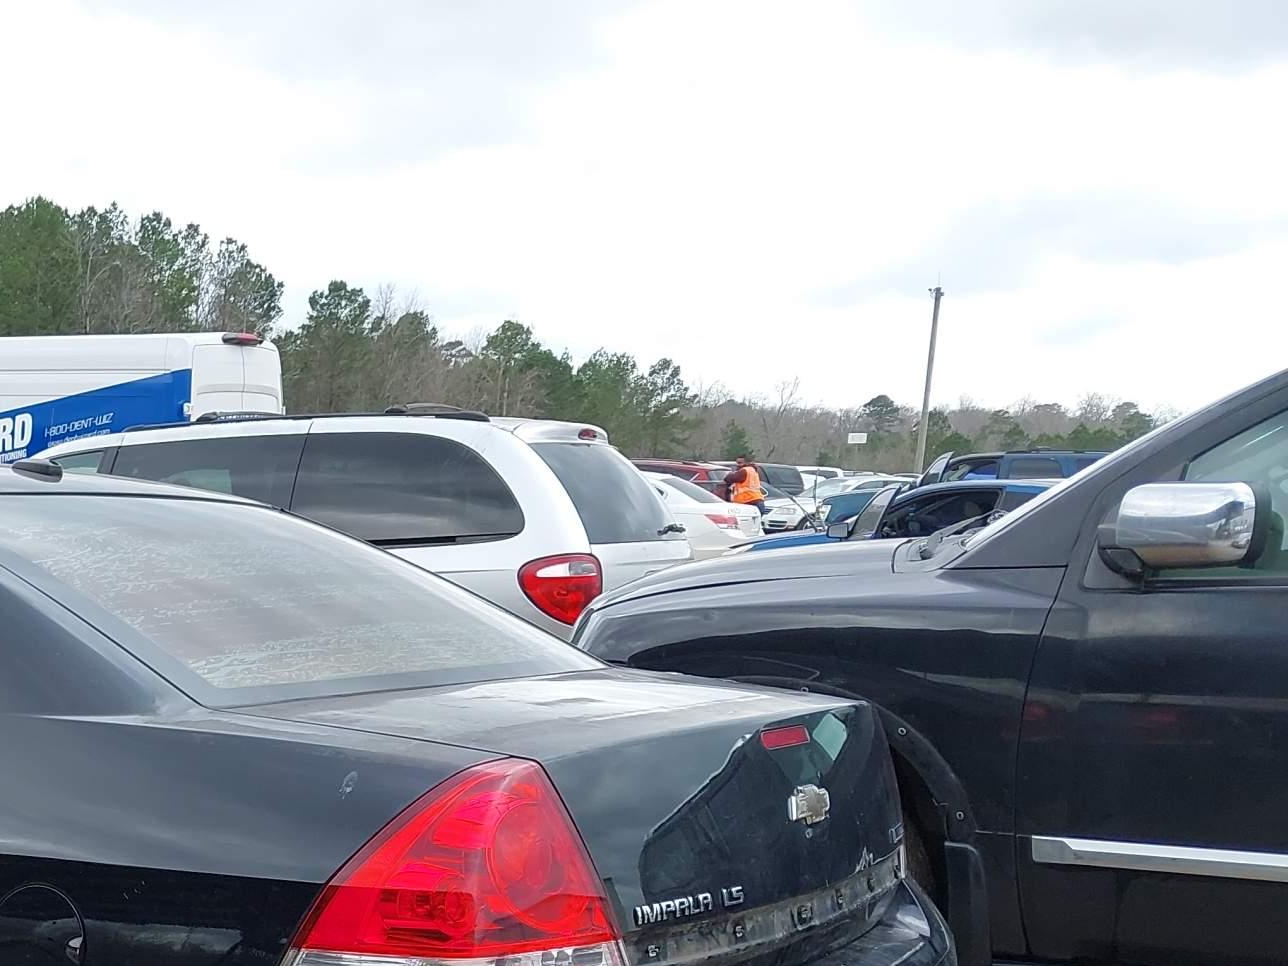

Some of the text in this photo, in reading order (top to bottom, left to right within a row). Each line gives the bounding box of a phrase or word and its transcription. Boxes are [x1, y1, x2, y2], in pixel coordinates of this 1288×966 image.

[44, 412, 115, 438] 1-800-DENT-WIZ
[634, 885, 745, 925] IMPALA LS
